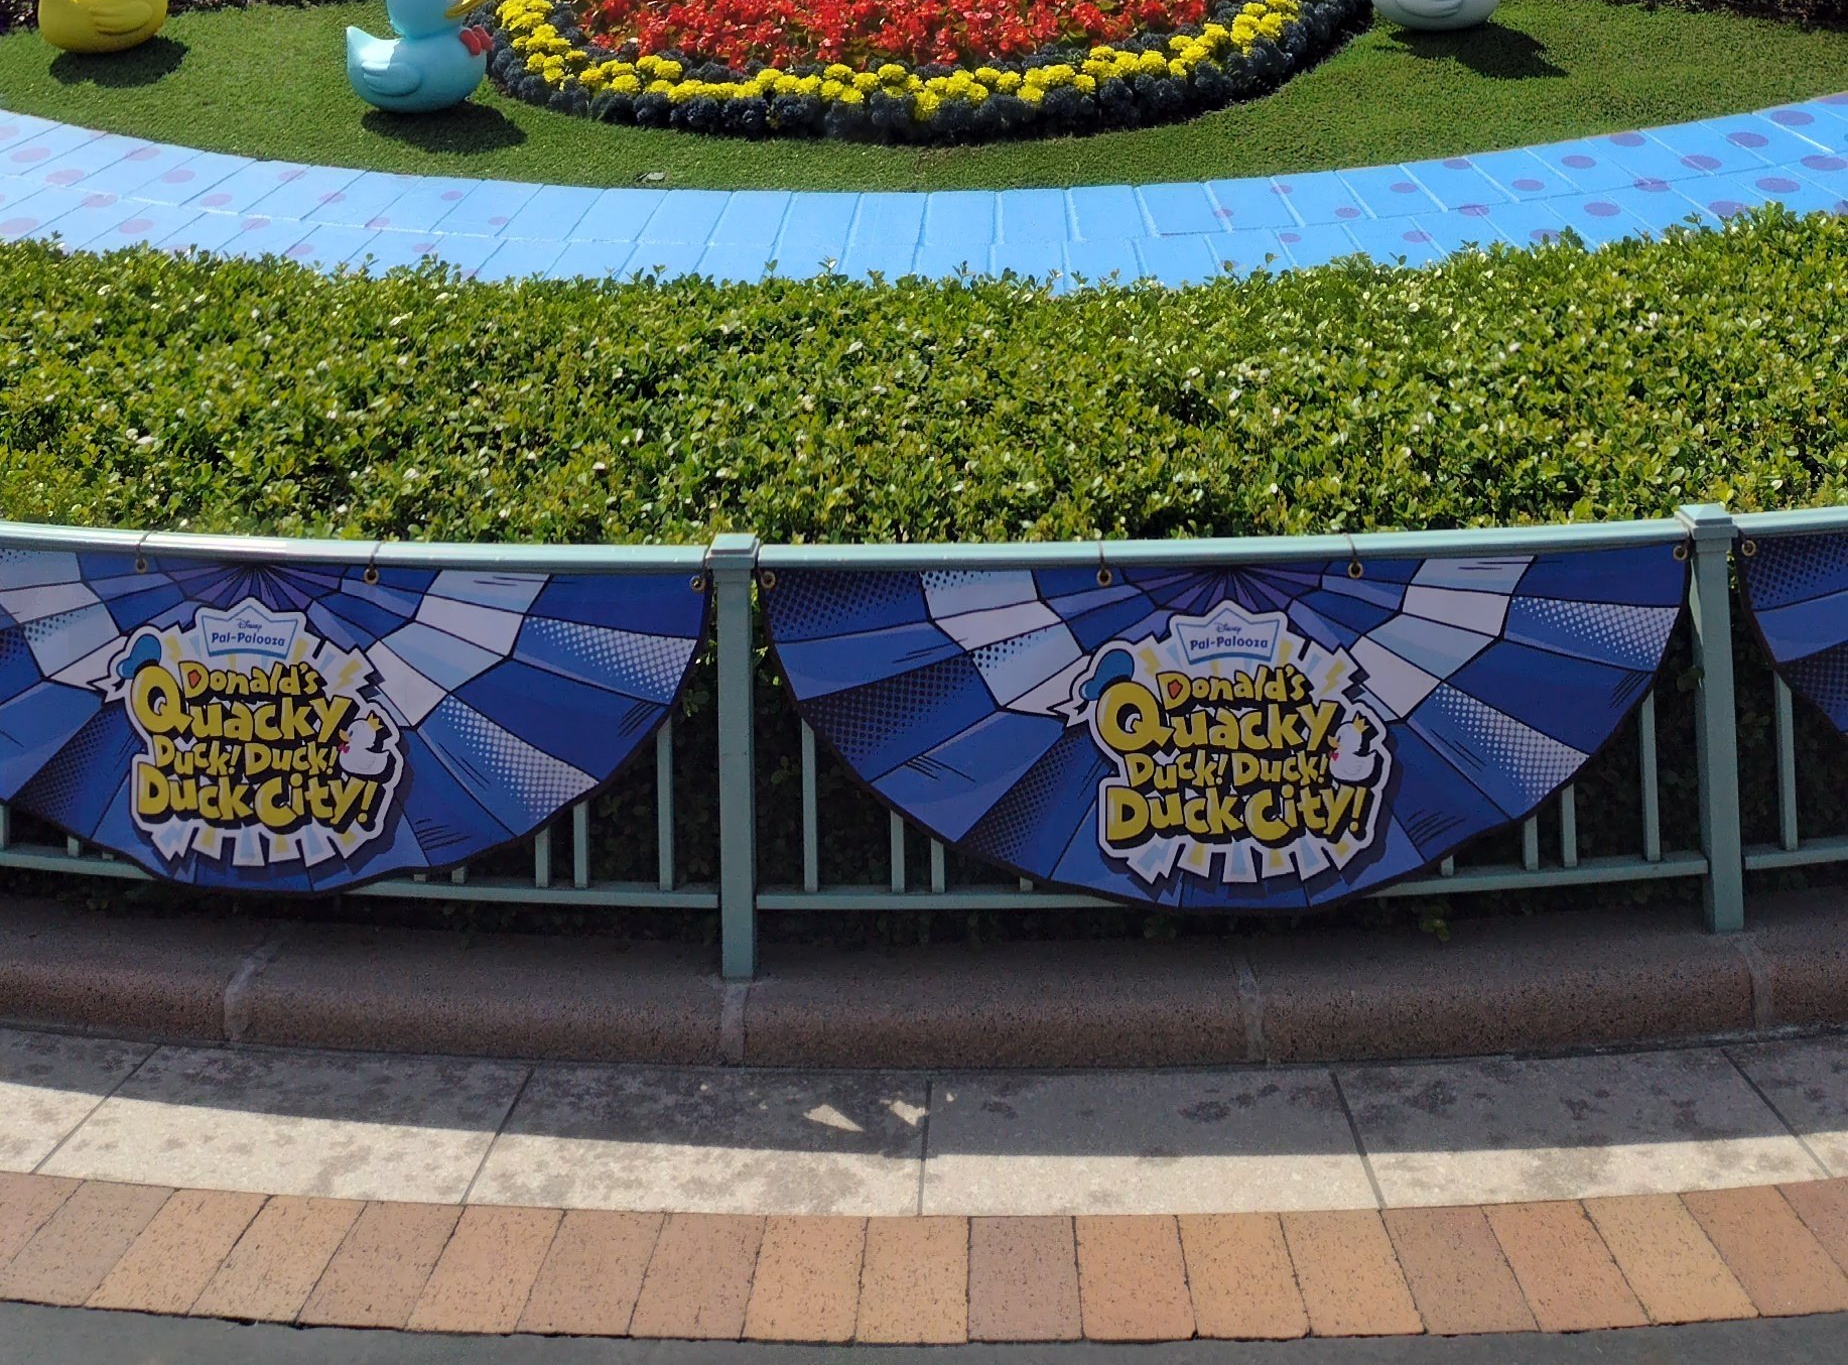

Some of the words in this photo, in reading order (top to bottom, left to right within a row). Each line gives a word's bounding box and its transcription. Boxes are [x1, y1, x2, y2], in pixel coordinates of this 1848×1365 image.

[211, 632, 286, 647] Pal-Palooza
[236, 619, 262, 632] Disney
[1190, 636, 1268, 650] Pal-Palooza
[1215, 622, 1242, 635] Disney
[179, 662, 320, 699] Donald's
[1156, 664, 1306, 710] Donald's
[131, 666, 352, 743] Quacky
[1096, 681, 1339, 751] Quacky
[153, 734, 242, 776] Duck!
[245, 740, 339, 776] Duck!
[1124, 749, 1229, 790] Duck!
[1232, 747, 1328, 787] Duck!
[137, 762, 253, 821] Duck
[254, 772, 378, 827] City!
[1106, 786, 1244, 841] Duck
[1245, 784, 1367, 841] City!
